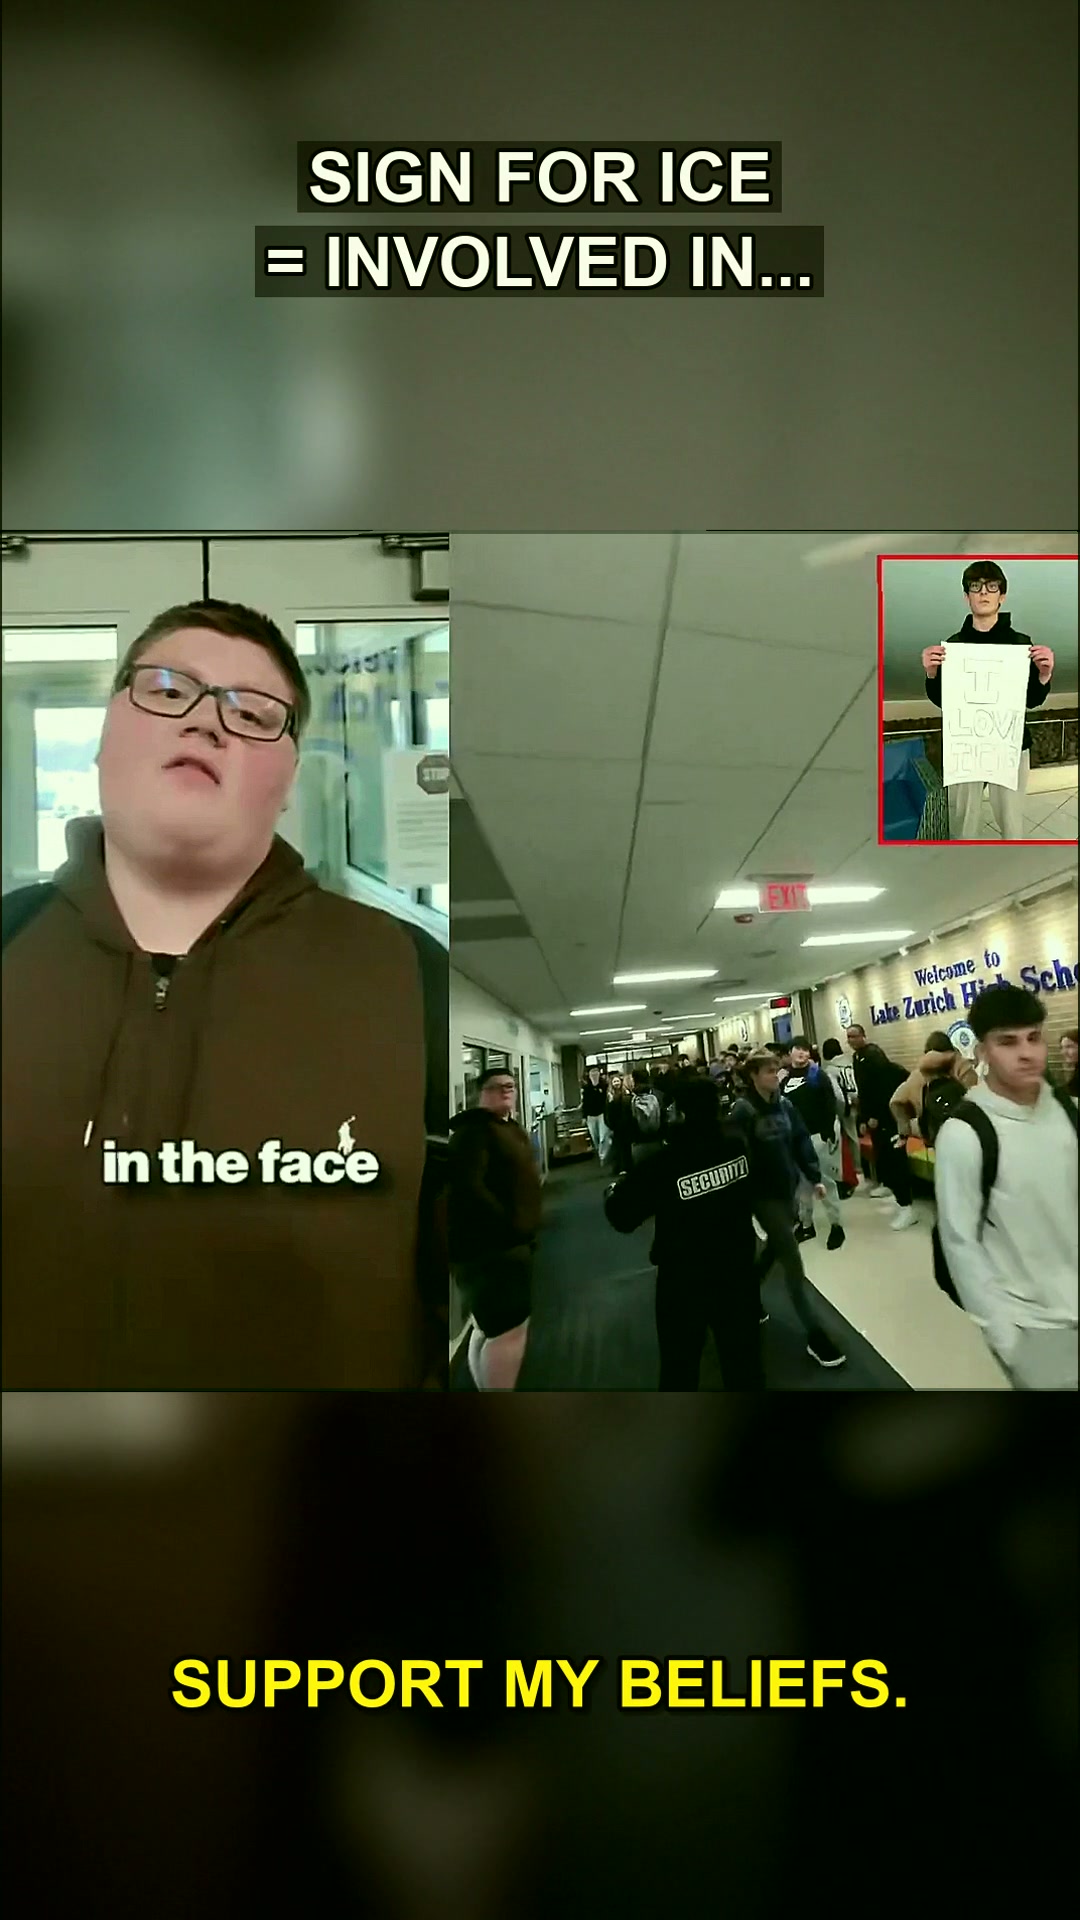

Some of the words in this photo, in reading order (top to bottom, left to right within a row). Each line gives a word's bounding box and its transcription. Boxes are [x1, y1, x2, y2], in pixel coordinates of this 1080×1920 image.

[963, 658, 1003, 704] I
[767, 883, 807, 911] EXIT
[914, 957, 976, 987] Welcome
[984, 948, 1001, 968] to
[870, 1002, 901, 1026] Lake
[903, 987, 957, 1020] Zurich
